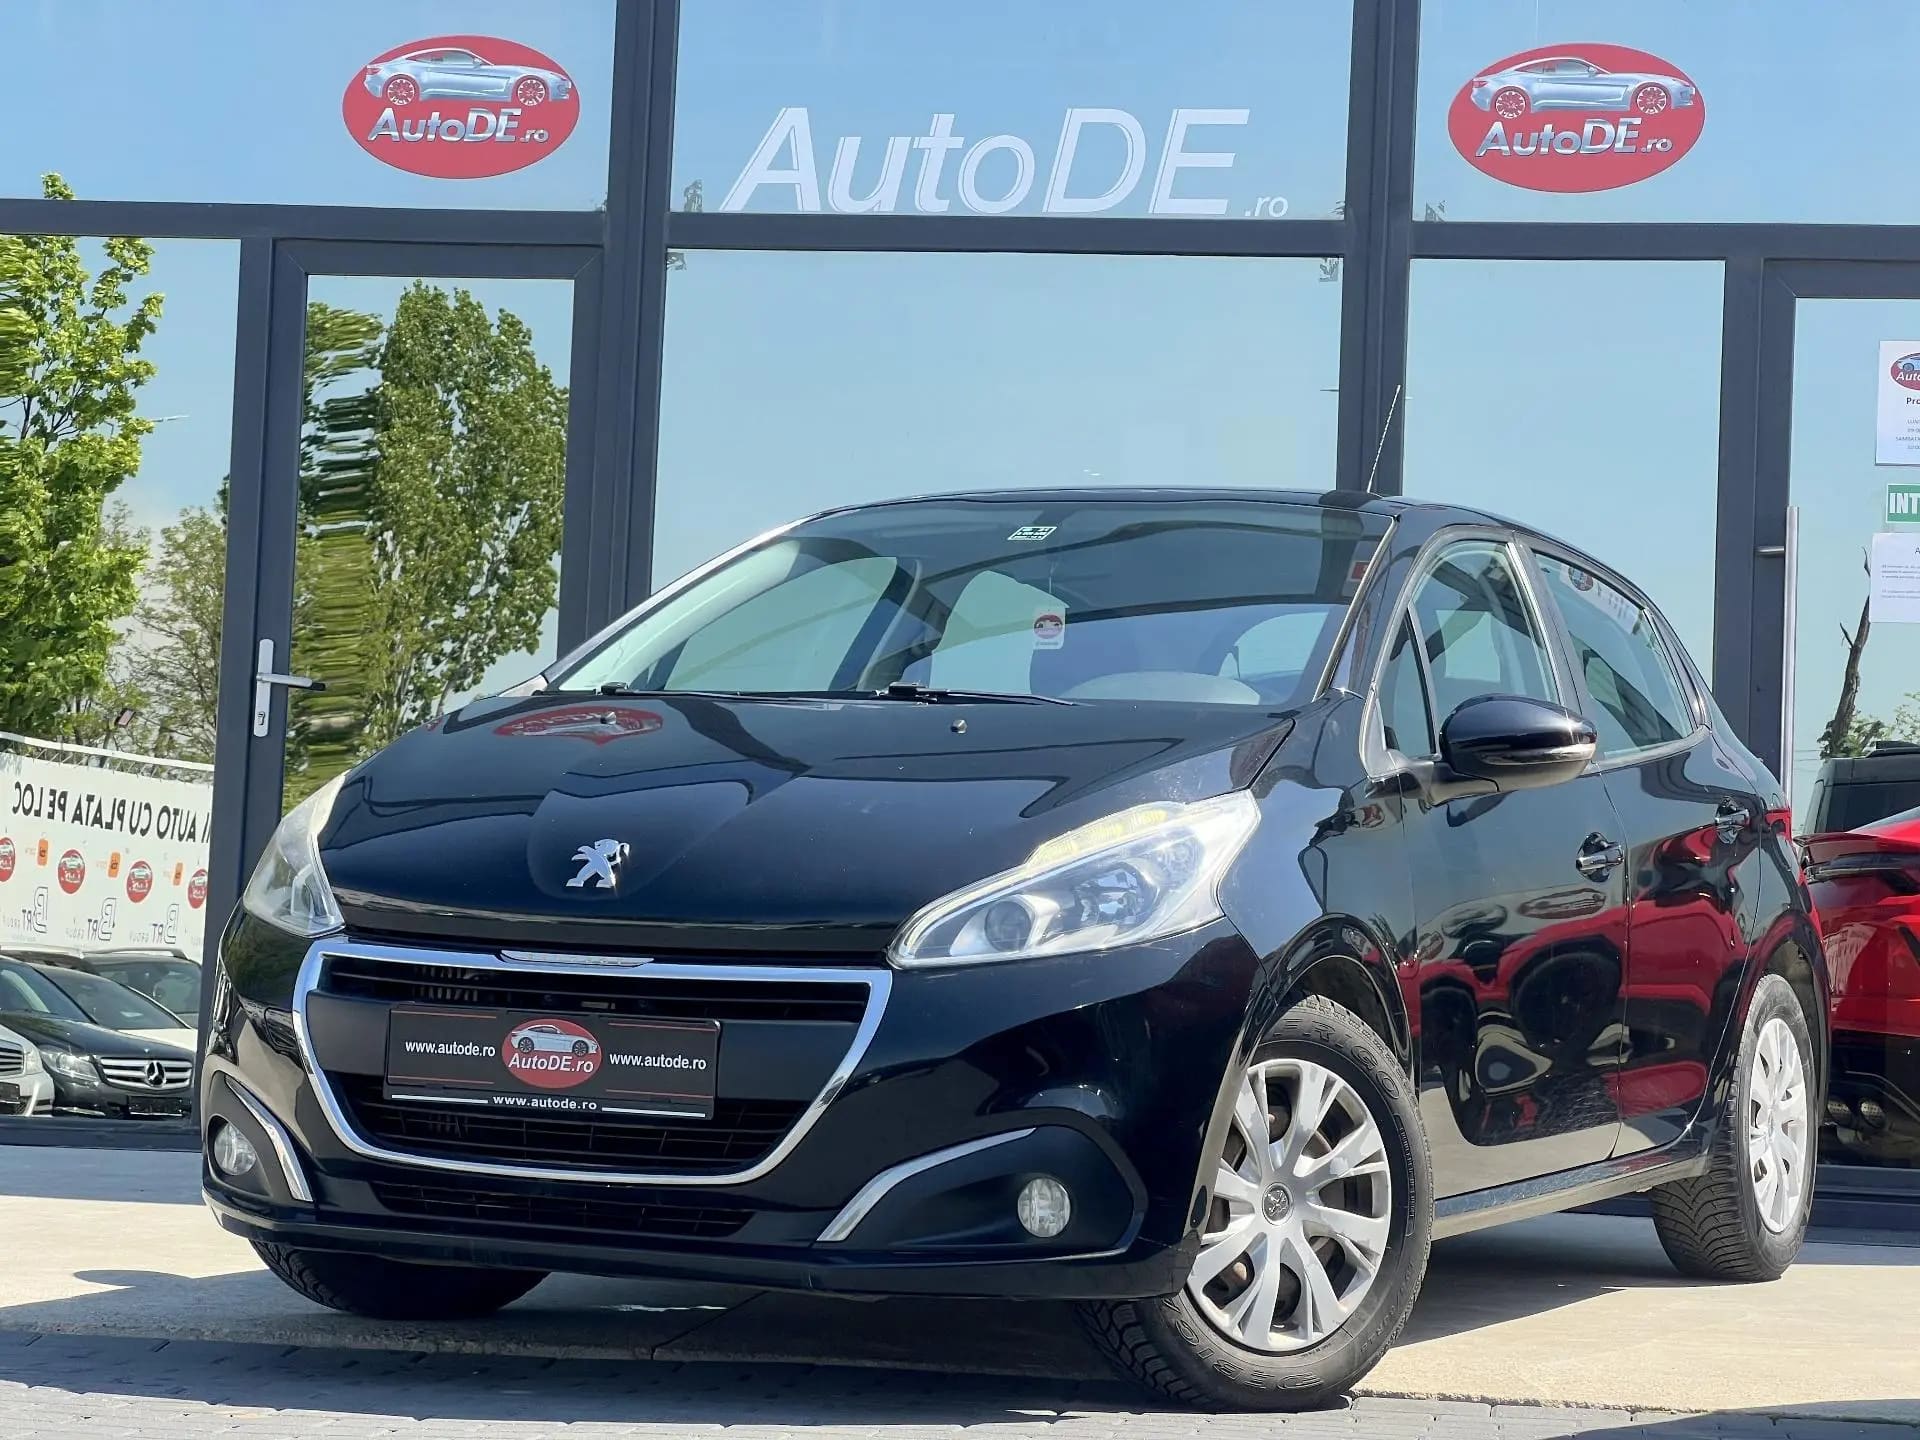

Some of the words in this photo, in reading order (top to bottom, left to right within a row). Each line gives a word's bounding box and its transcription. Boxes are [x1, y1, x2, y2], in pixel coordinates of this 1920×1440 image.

[1889, 492, 1920, 514] INT
[404, 1040, 496, 1057] www.autode.ro
[508, 1051, 594, 1074] AutoDE.ro
[609, 1052, 707, 1070] www.autode.ro
[492, 1094, 597, 1110] www.autode.ro
